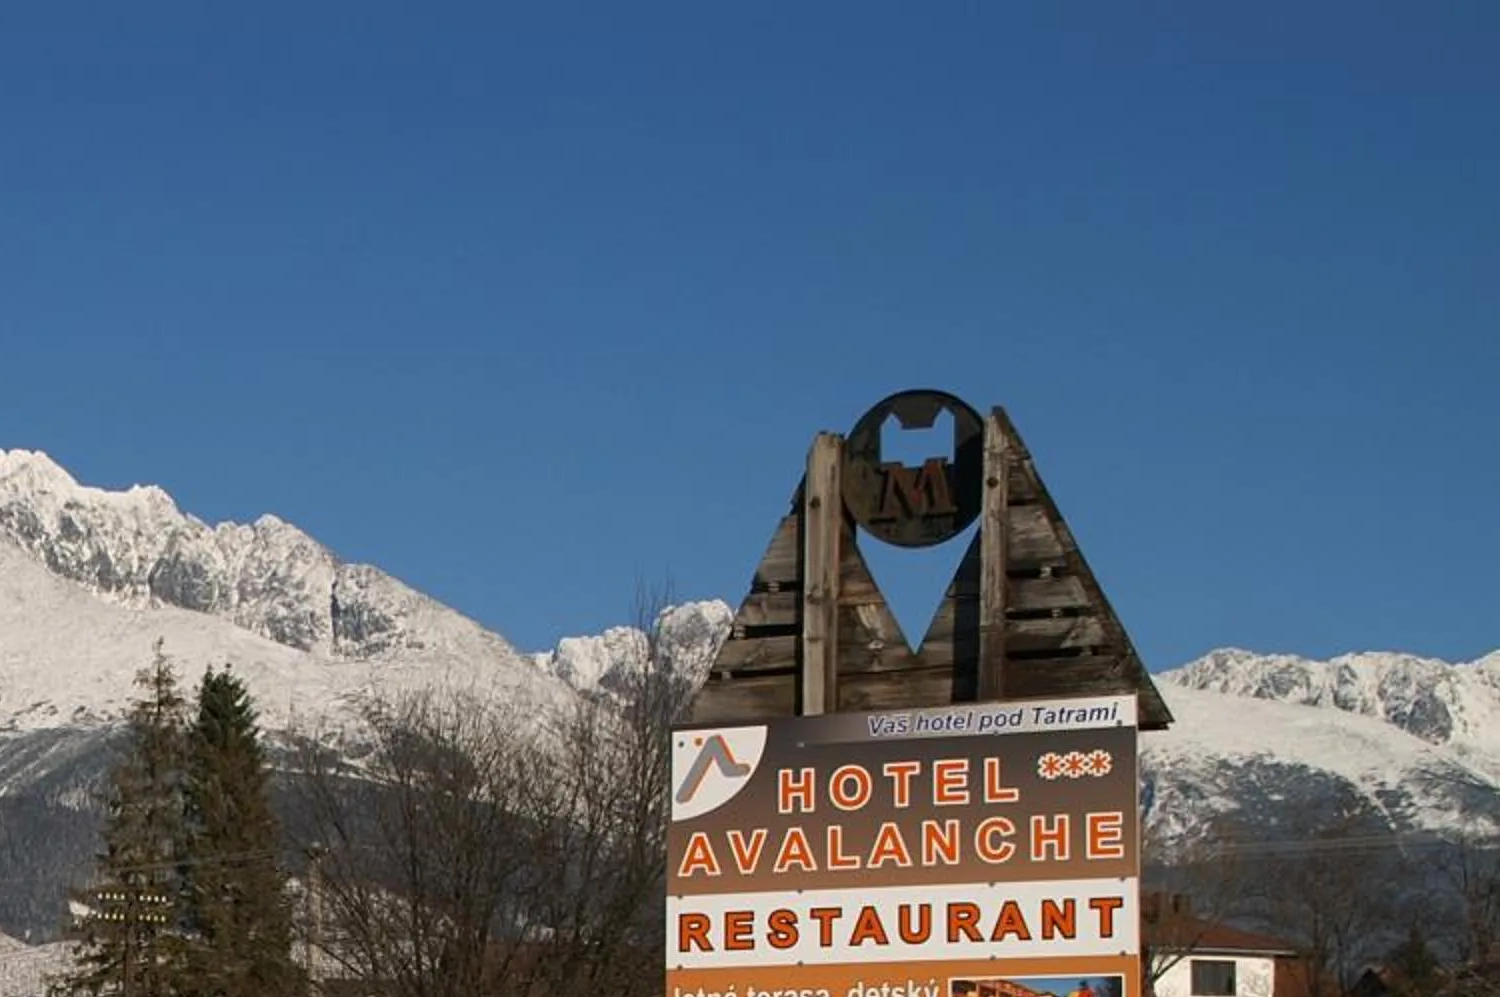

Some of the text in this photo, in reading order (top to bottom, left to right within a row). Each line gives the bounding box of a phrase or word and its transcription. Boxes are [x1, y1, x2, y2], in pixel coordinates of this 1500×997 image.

[916, 709, 972, 732] hotel
[979, 708, 1023, 732] pod
[1032, 702, 1119, 726] Tatrami
[778, 758, 1019, 813] HOTEL
[677, 813, 1125, 877] AVALANCHE
[677, 897, 1125, 953] RESTAURANT
